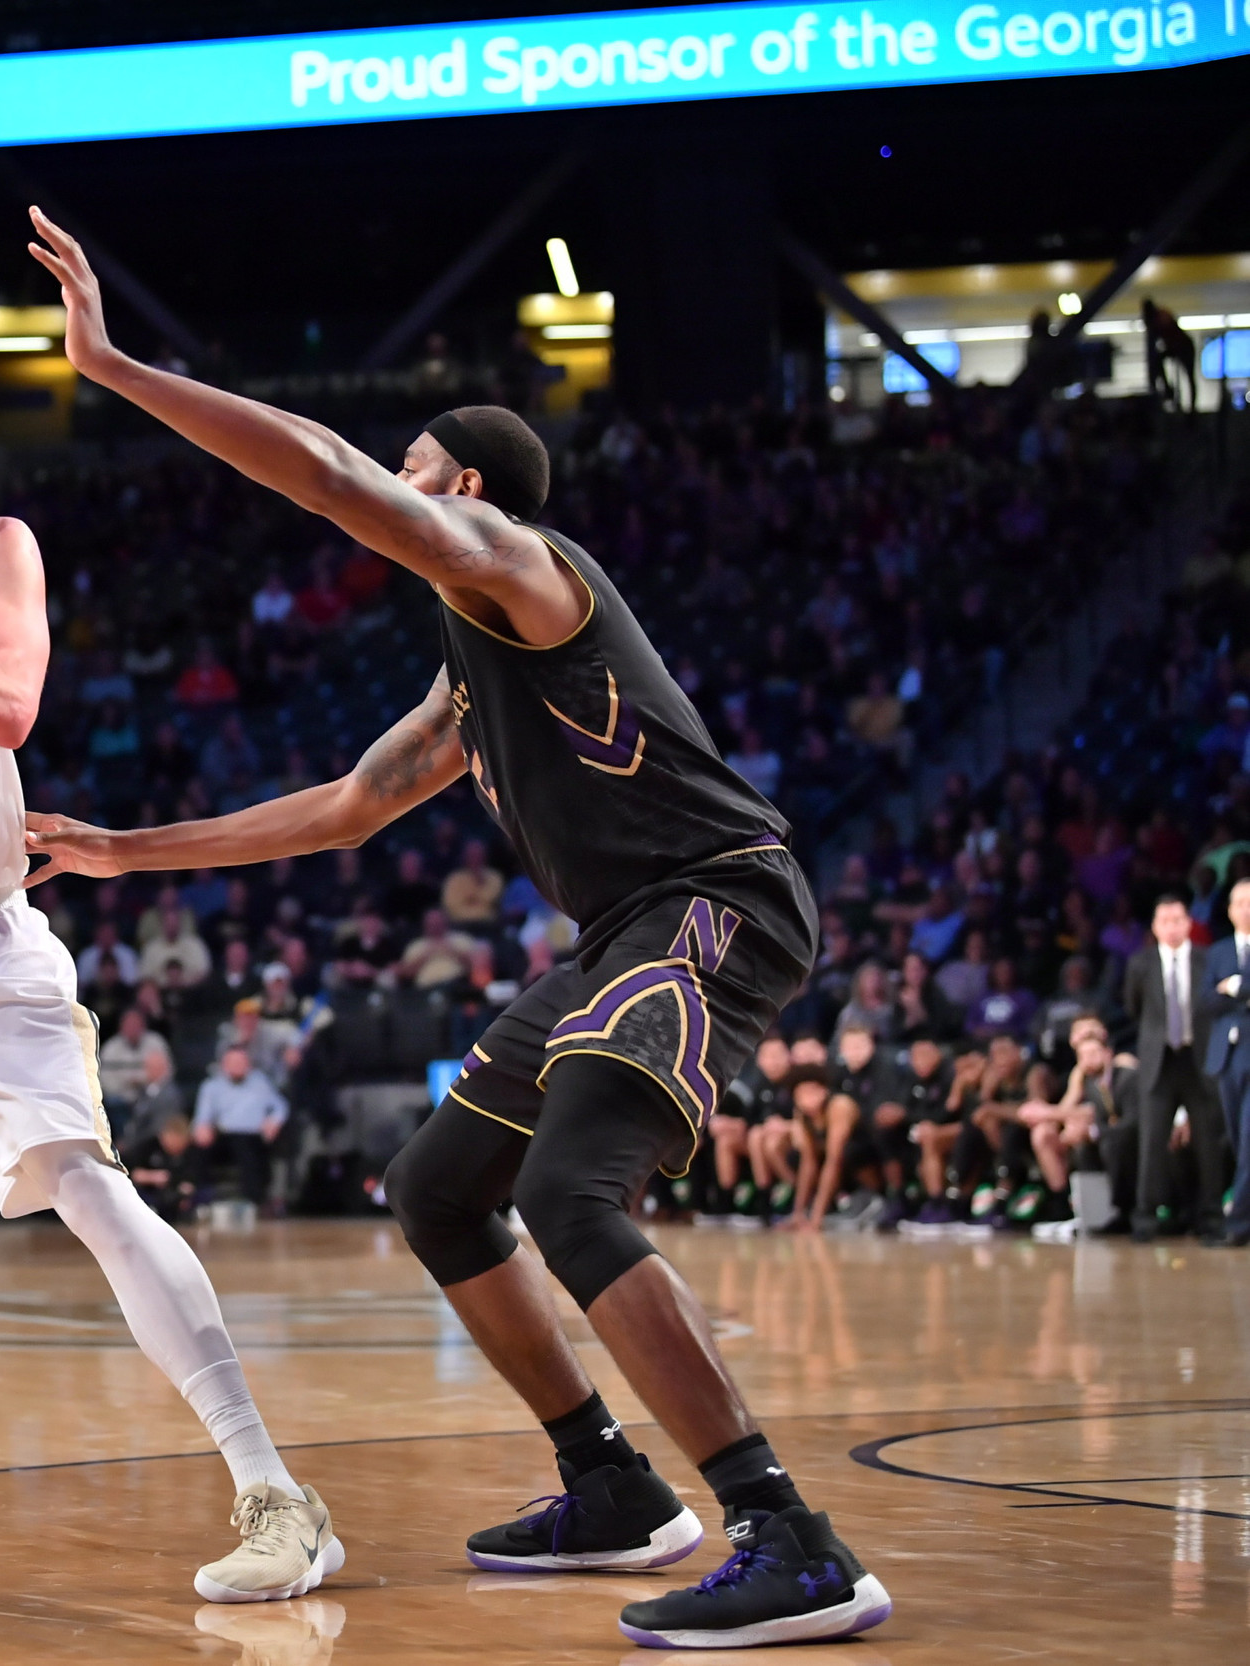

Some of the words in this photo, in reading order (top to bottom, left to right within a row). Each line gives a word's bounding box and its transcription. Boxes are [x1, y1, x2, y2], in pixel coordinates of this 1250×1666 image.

[290, 37, 467, 107] Proud
[482, 33, 737, 106] Sponsor
[751, 11, 820, 75] of
[830, 9, 939, 71] the
[954, 3, 1196, 66] Georgia
